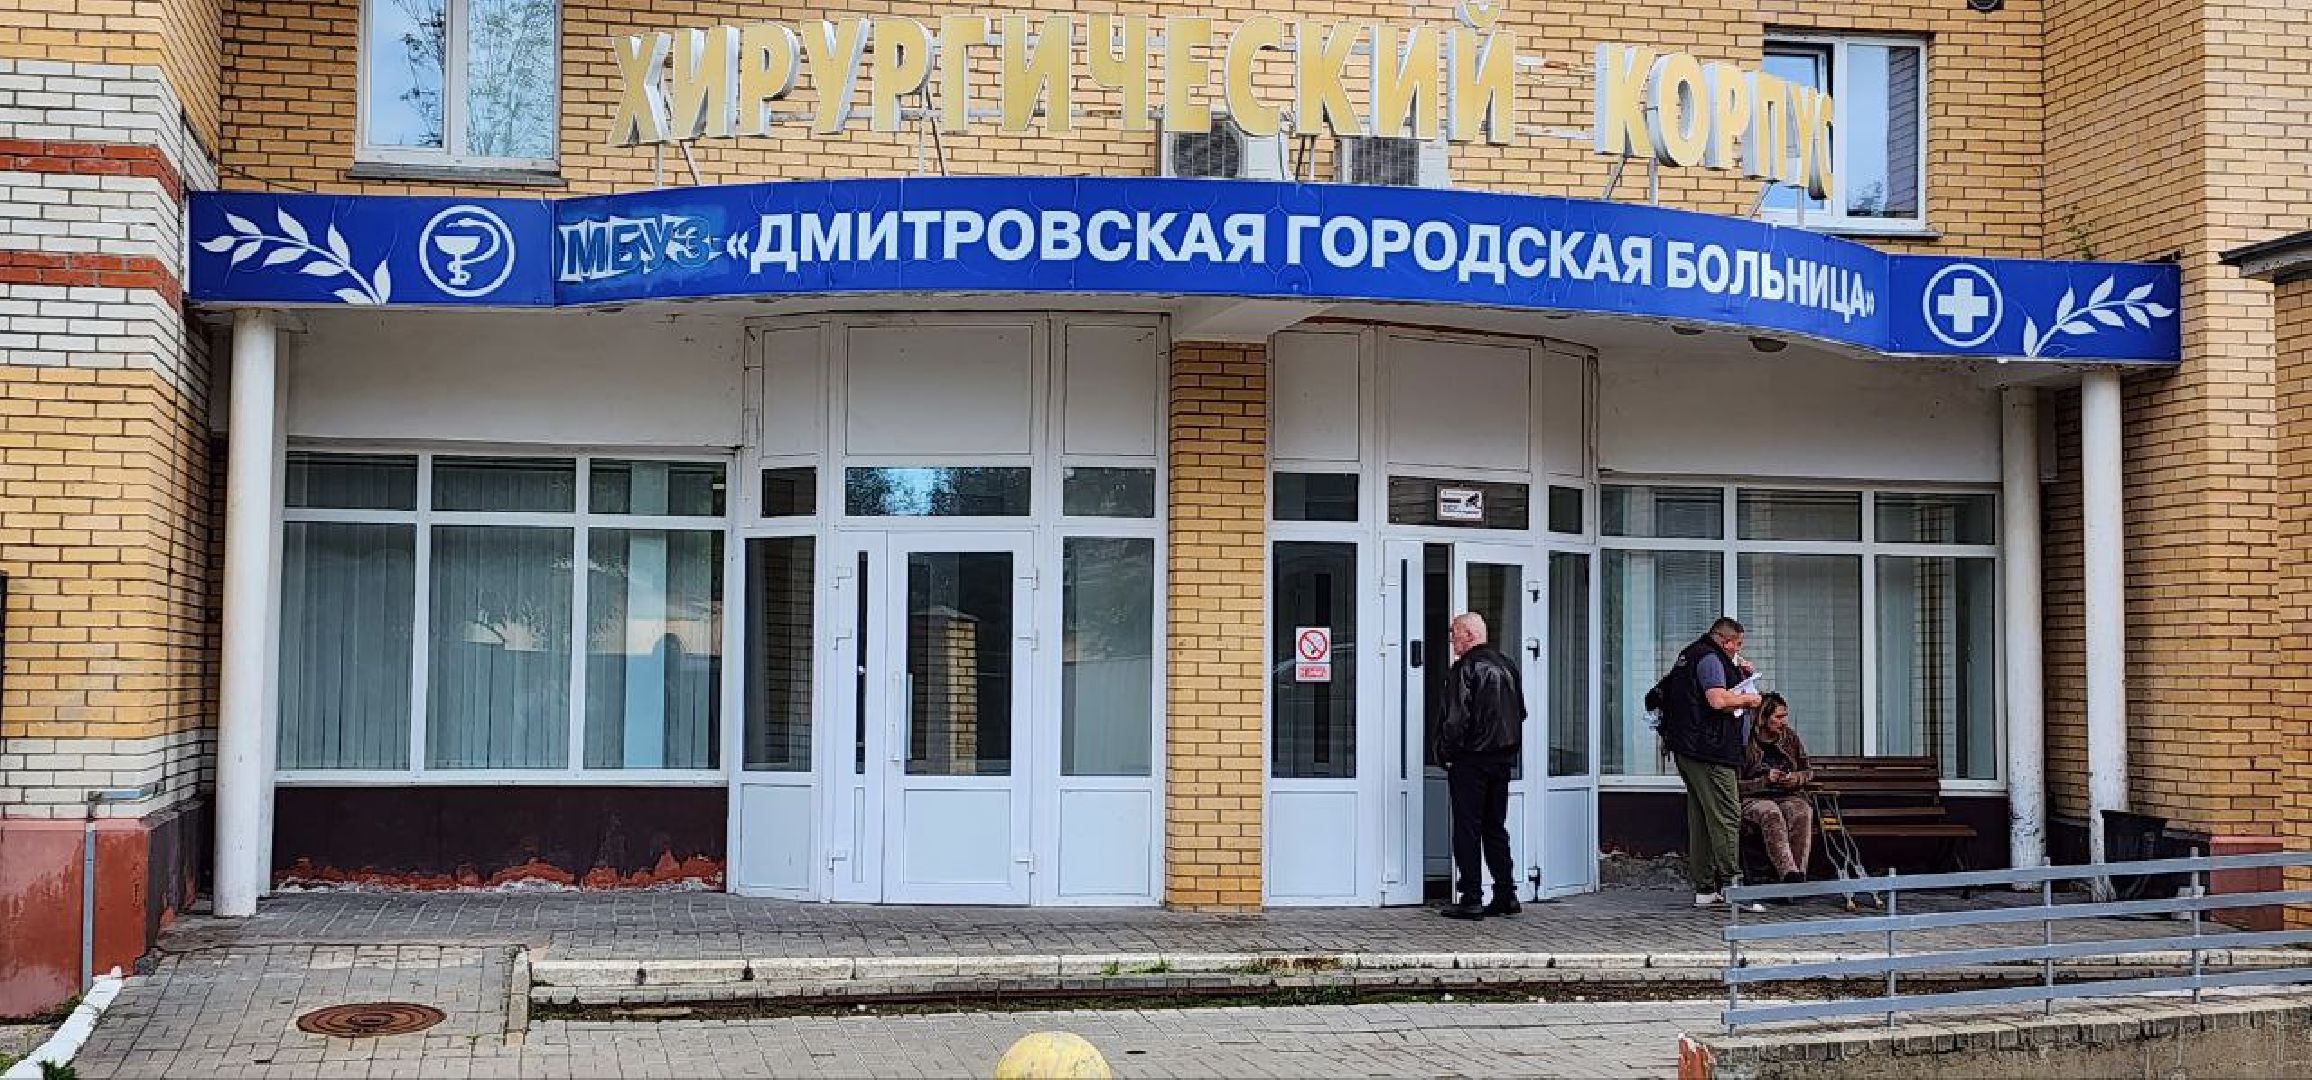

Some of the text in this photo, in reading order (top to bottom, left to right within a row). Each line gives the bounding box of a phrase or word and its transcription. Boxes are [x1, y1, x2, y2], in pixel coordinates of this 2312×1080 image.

[609, 0, 1834, 200] ХИРУРГИЧЕСКИЙ КОРПУС
[726, 209, 1266, 274] «ДМИТРОВСКАЯ
[1286, 214, 1653, 286] ГОРОДСКАЯ
[1667, 240, 1875, 324] БОЛЬНИЦА»
